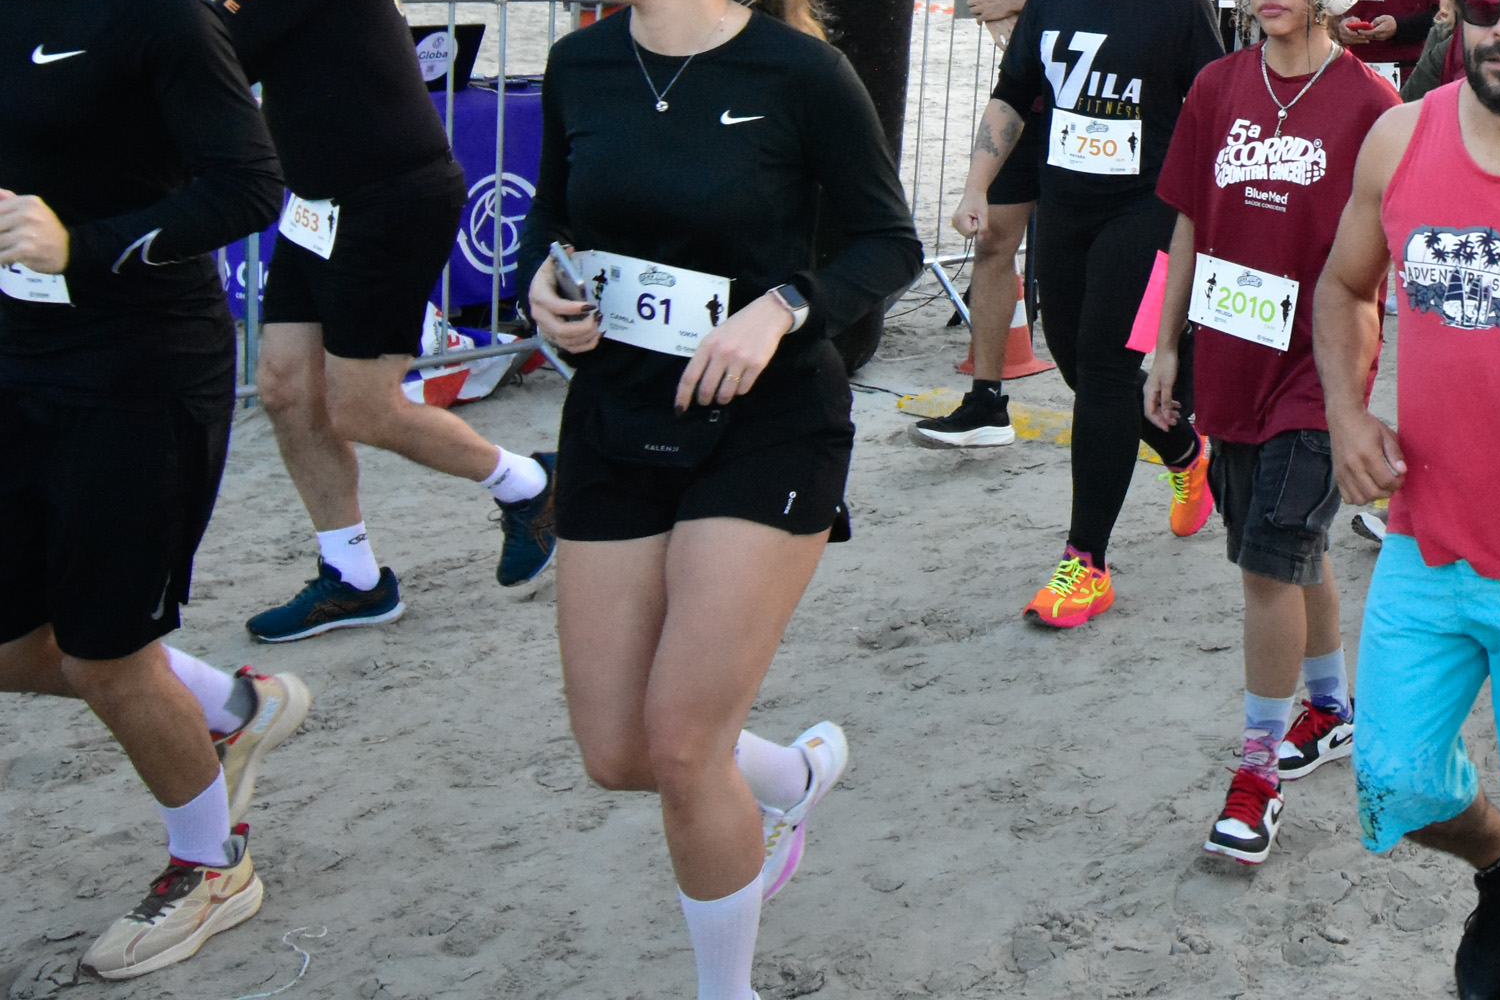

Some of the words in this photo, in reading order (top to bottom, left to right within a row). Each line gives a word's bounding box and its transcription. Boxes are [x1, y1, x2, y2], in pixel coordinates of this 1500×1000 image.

[418, 50, 448, 59] Globa
[1076, 135, 1118, 157] 750
[1229, 136, 1327, 169] CORRIDA
[1244, 186, 1268, 200] Blue
[1268, 190, 1289, 205] Med
[294, 205, 320, 233] 653
[636, 292, 672, 325] 61
[1216, 286, 1276, 323] 2010
[609, 312, 635, 324] CAMILA
[644, 444, 680, 452] KALENJI
